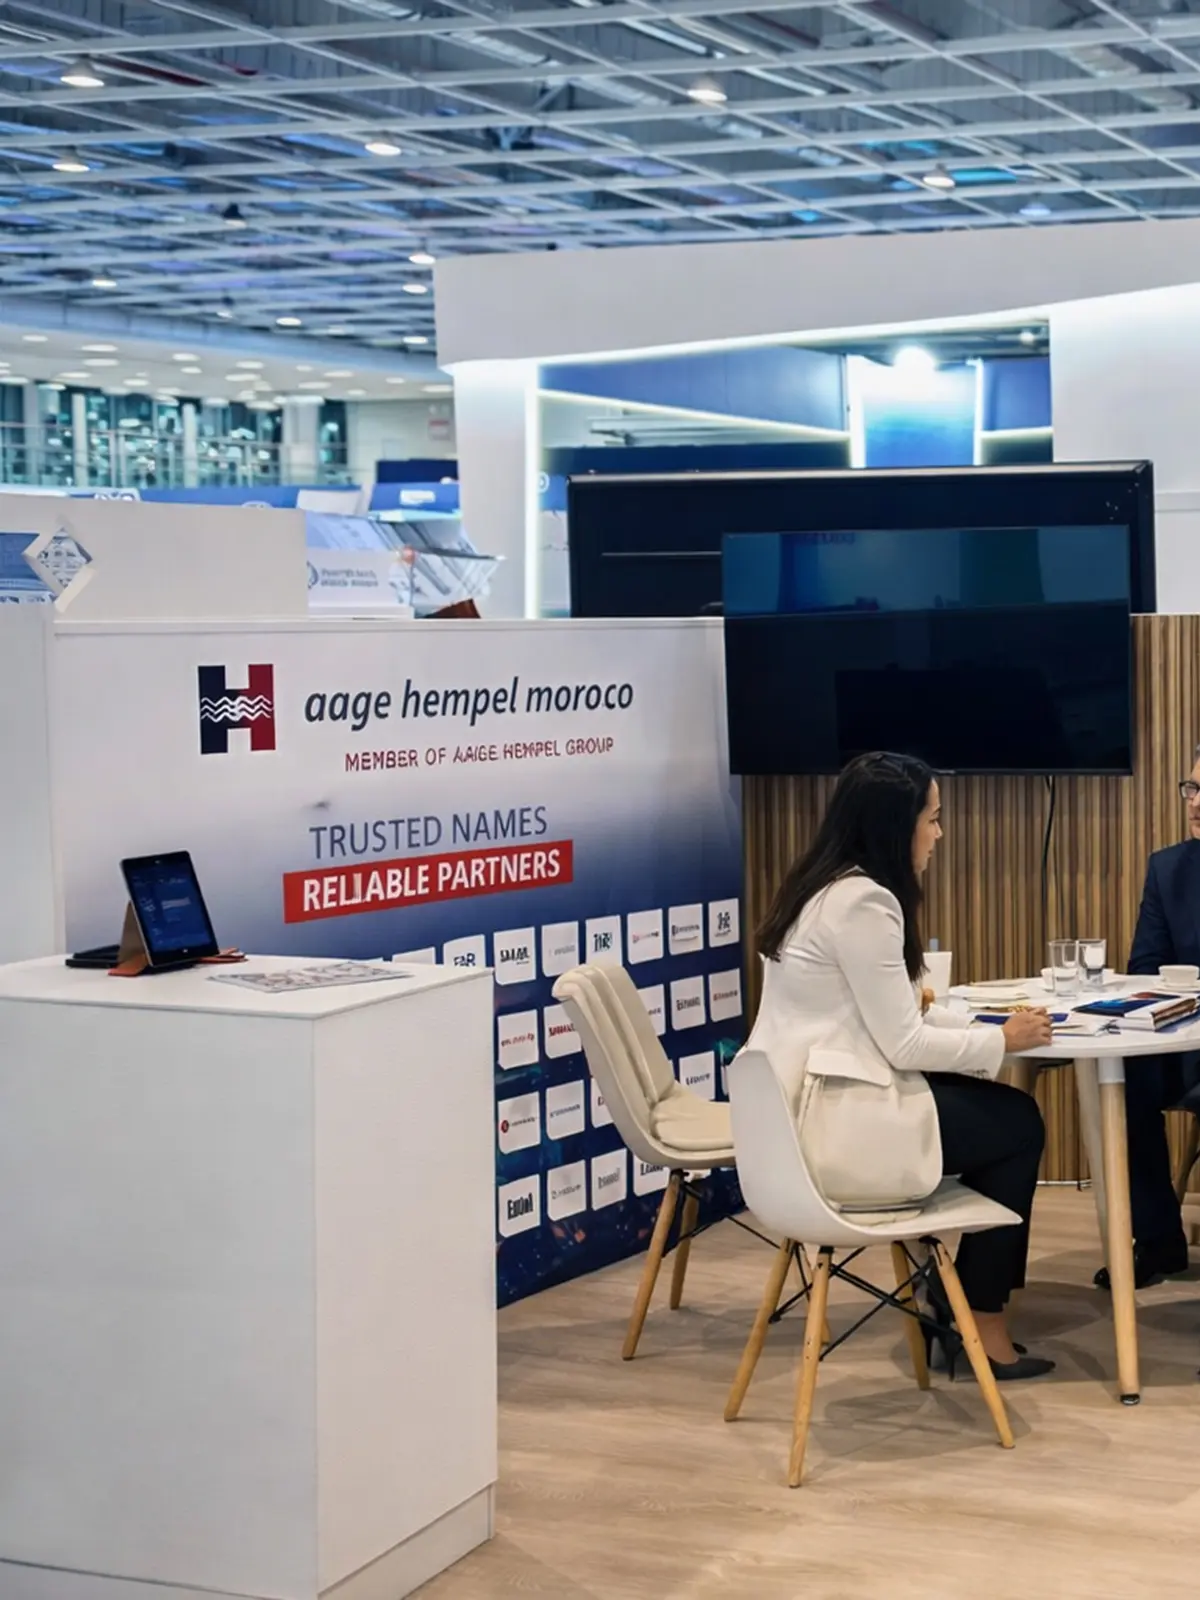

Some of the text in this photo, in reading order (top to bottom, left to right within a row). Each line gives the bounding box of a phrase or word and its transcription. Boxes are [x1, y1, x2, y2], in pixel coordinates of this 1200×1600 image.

[304, 690, 392, 731] aage
[401, 676, 519, 727] hempel
[526, 683, 634, 712] moroco
[345, 750, 419, 772] MEMBER
[425, 747, 447, 766] OF
[503, 740, 561, 760] HEMPEL
[566, 737, 614, 756] GROUP
[309, 806, 547, 859] TRUSTED NAMES
[303, 848, 560, 912] RELIABLE PARTNERS
